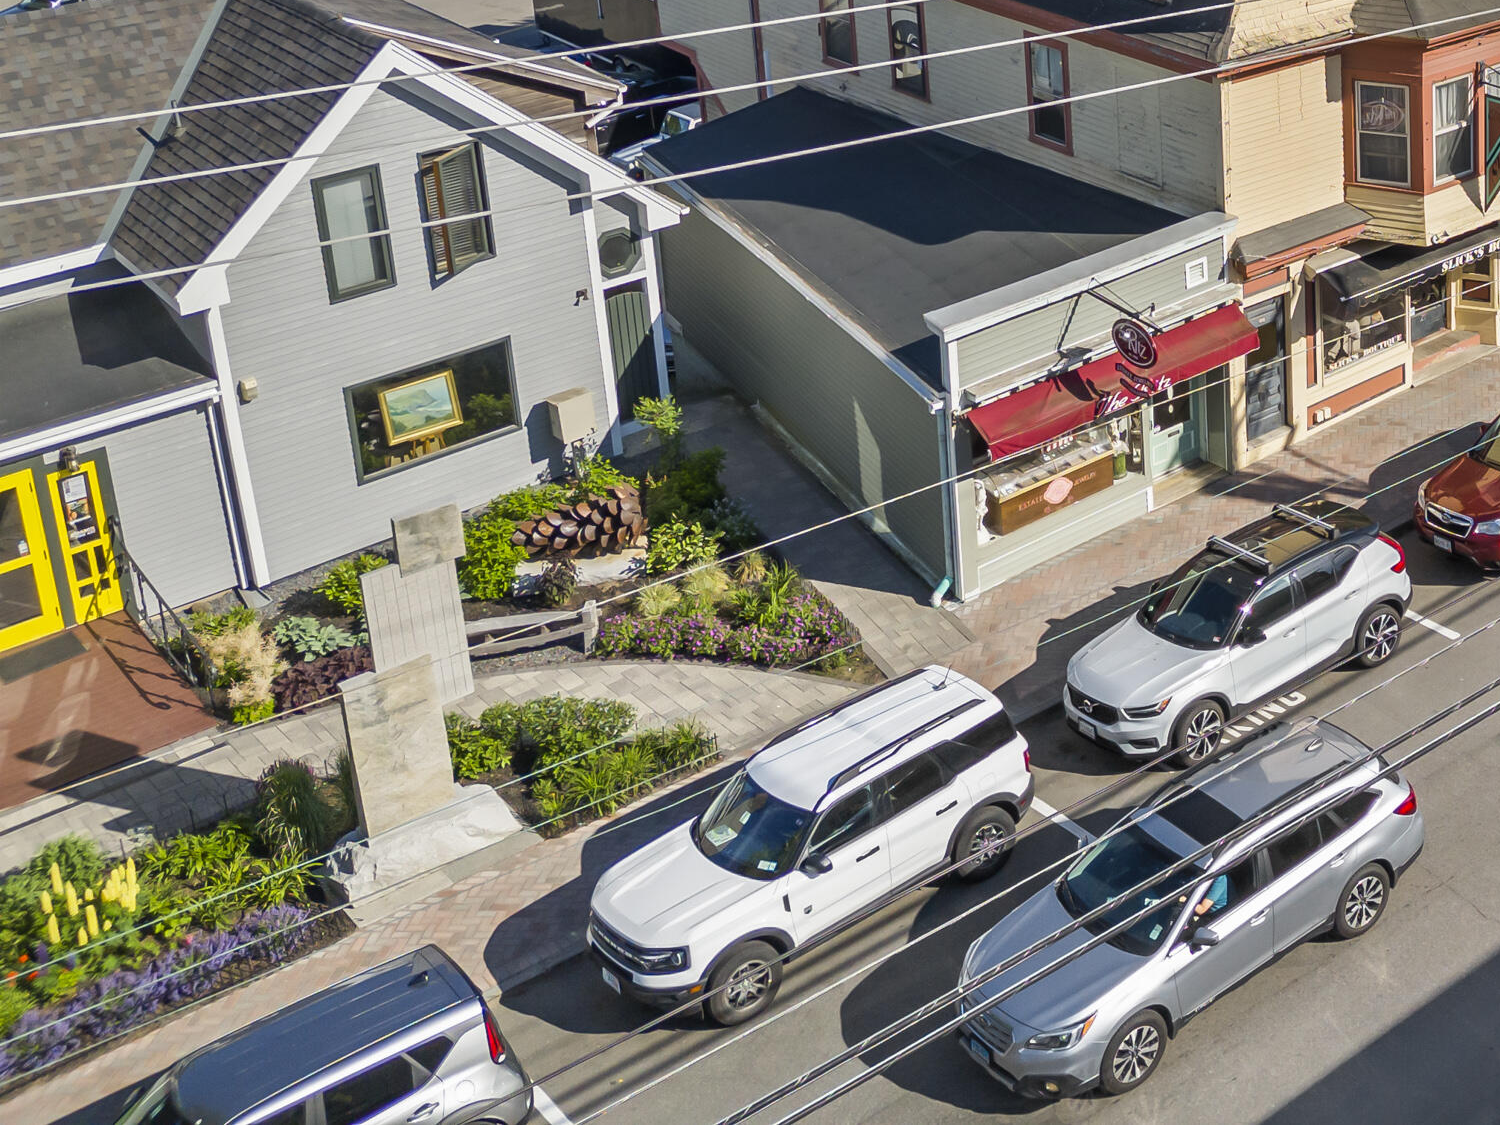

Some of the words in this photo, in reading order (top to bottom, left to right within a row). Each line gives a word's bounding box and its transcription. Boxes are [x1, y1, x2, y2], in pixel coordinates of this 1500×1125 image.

[1441, 246, 1485, 273] SLICK'S
[1363, 333, 1402, 356] BOUTIQUE
[1222, 690, 1307, 745] KING
